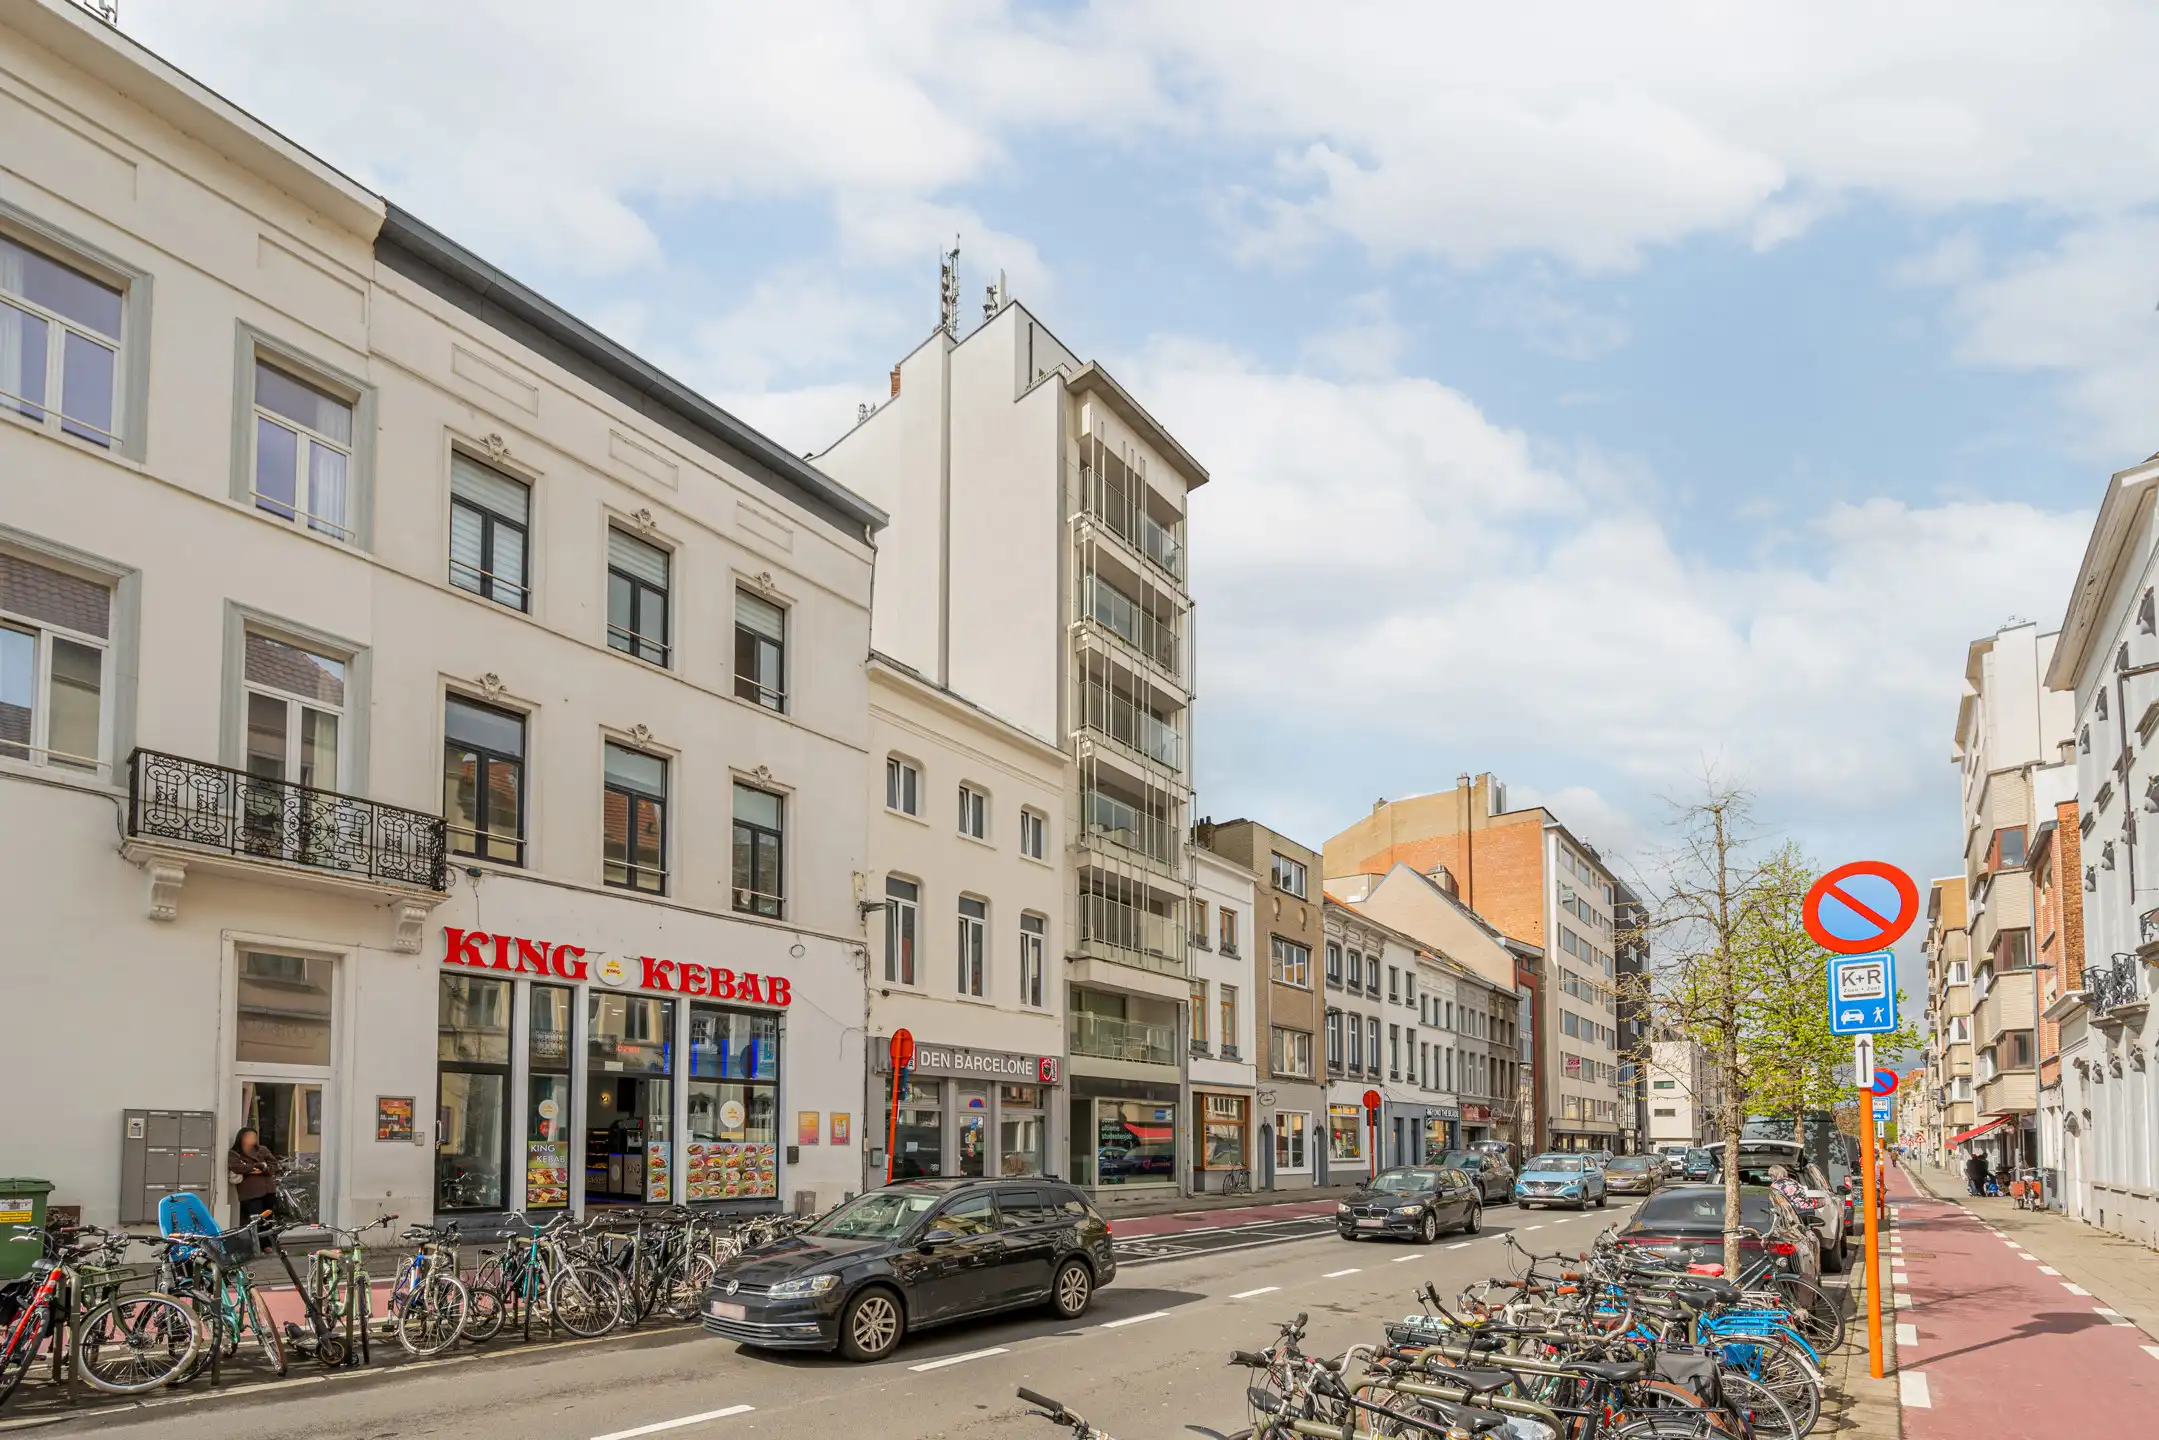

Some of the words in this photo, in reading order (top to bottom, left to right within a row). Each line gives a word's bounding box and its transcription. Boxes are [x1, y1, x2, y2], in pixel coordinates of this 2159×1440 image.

[443, 926, 588, 980] KING
[640, 955, 791, 1006] KEBAB
[920, 1051, 950, 1067] DEN
[954, 1054, 1033, 1075] BARCELONE
[530, 1144, 556, 1152] KING
[536, 1155, 566, 1163] KEBAB
